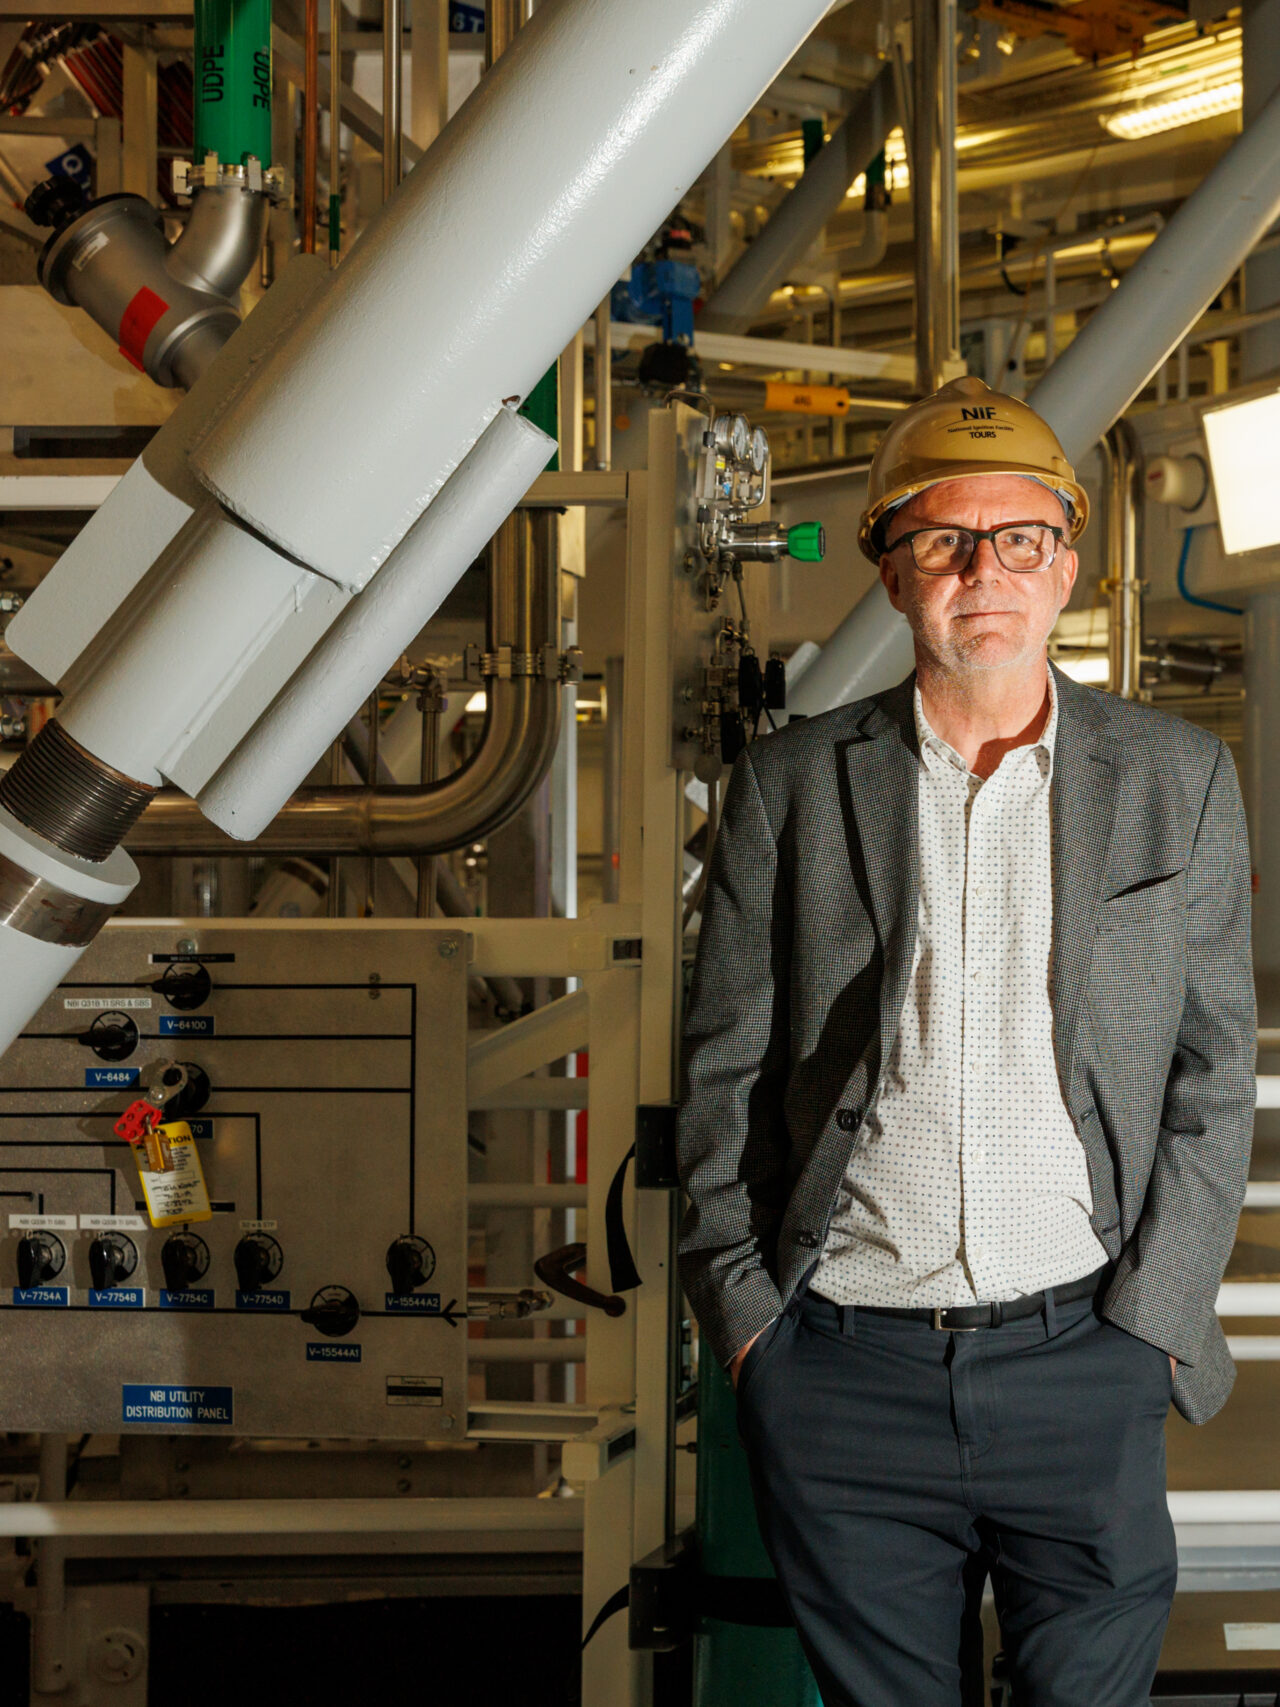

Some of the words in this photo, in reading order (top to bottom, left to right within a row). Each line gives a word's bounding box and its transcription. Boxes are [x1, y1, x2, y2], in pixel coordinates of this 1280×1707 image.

[203, 44, 225, 103] UDPE
[253, 51, 270, 112] UDPE
[961, 407, 996, 420] NIF
[969, 431, 997, 439] TOURS
[166, 1020, 207, 1030] V-64100
[95, 1072, 131, 1082] V-6484
[20, 1291, 62, 1301] V-7754A
[95, 1292, 137, 1302] V-7754B
[166, 1293, 208, 1304] V-7754C
[242, 1294, 284, 1305] V-7754D
[387, 1297, 439, 1307] V-15544A2
[309, 1347, 359, 1357] V-15544A1
[149, 1390, 166, 1402] NBI
[169, 1390, 206, 1403] UTILITY
[126, 1405, 193, 1418] DISTRIBUTION
[197, 1407, 229, 1419] PANEL
